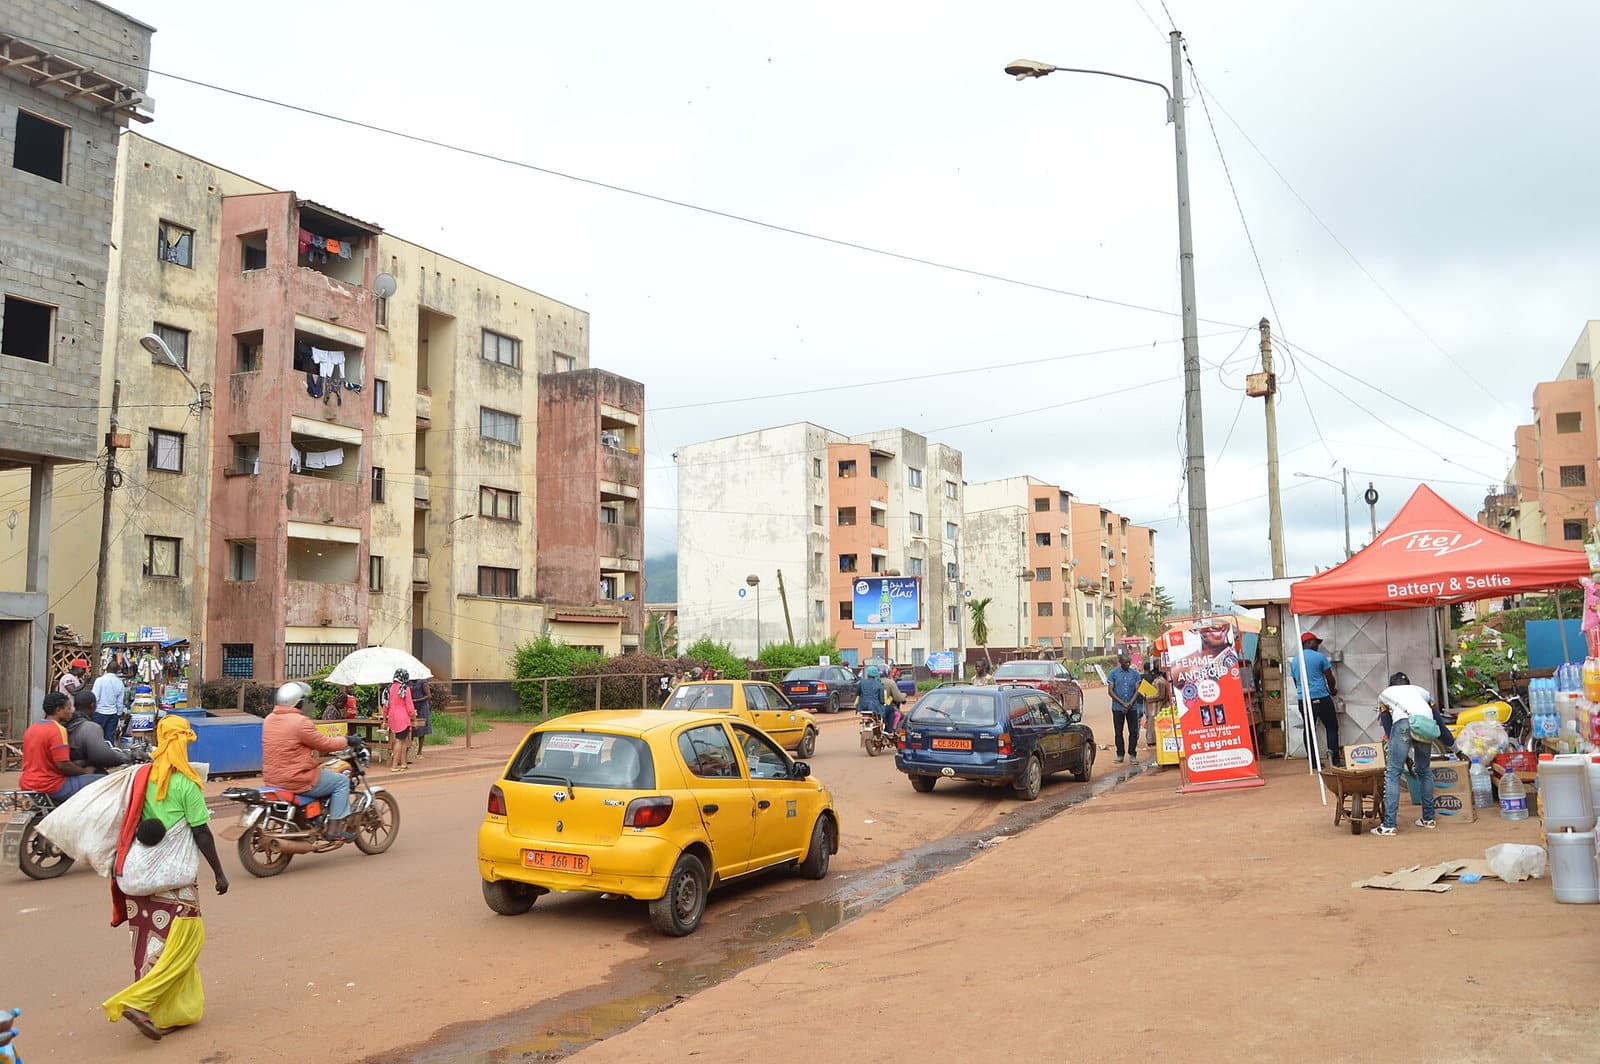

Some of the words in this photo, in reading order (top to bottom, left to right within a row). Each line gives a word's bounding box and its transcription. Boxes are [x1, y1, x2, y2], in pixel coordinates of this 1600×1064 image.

[1405, 533, 1463, 549] itel
[890, 587, 914, 598] Class
[1387, 581, 1445, 598] Battery
[1449, 577, 1462, 591] &
[1465, 573, 1512, 589] Selfie
[1175, 654, 1214, 668] FEMME
[1177, 665, 1229, 682] ANDROID
[1191, 741, 1202, 750] et
[1203, 735, 1242, 751] gagnez!
[1351, 750, 1377, 758] AZUR
[1434, 799, 1461, 808] AZUR
[534, 852, 545, 866] CE
[551, 854, 568, 868] 160
